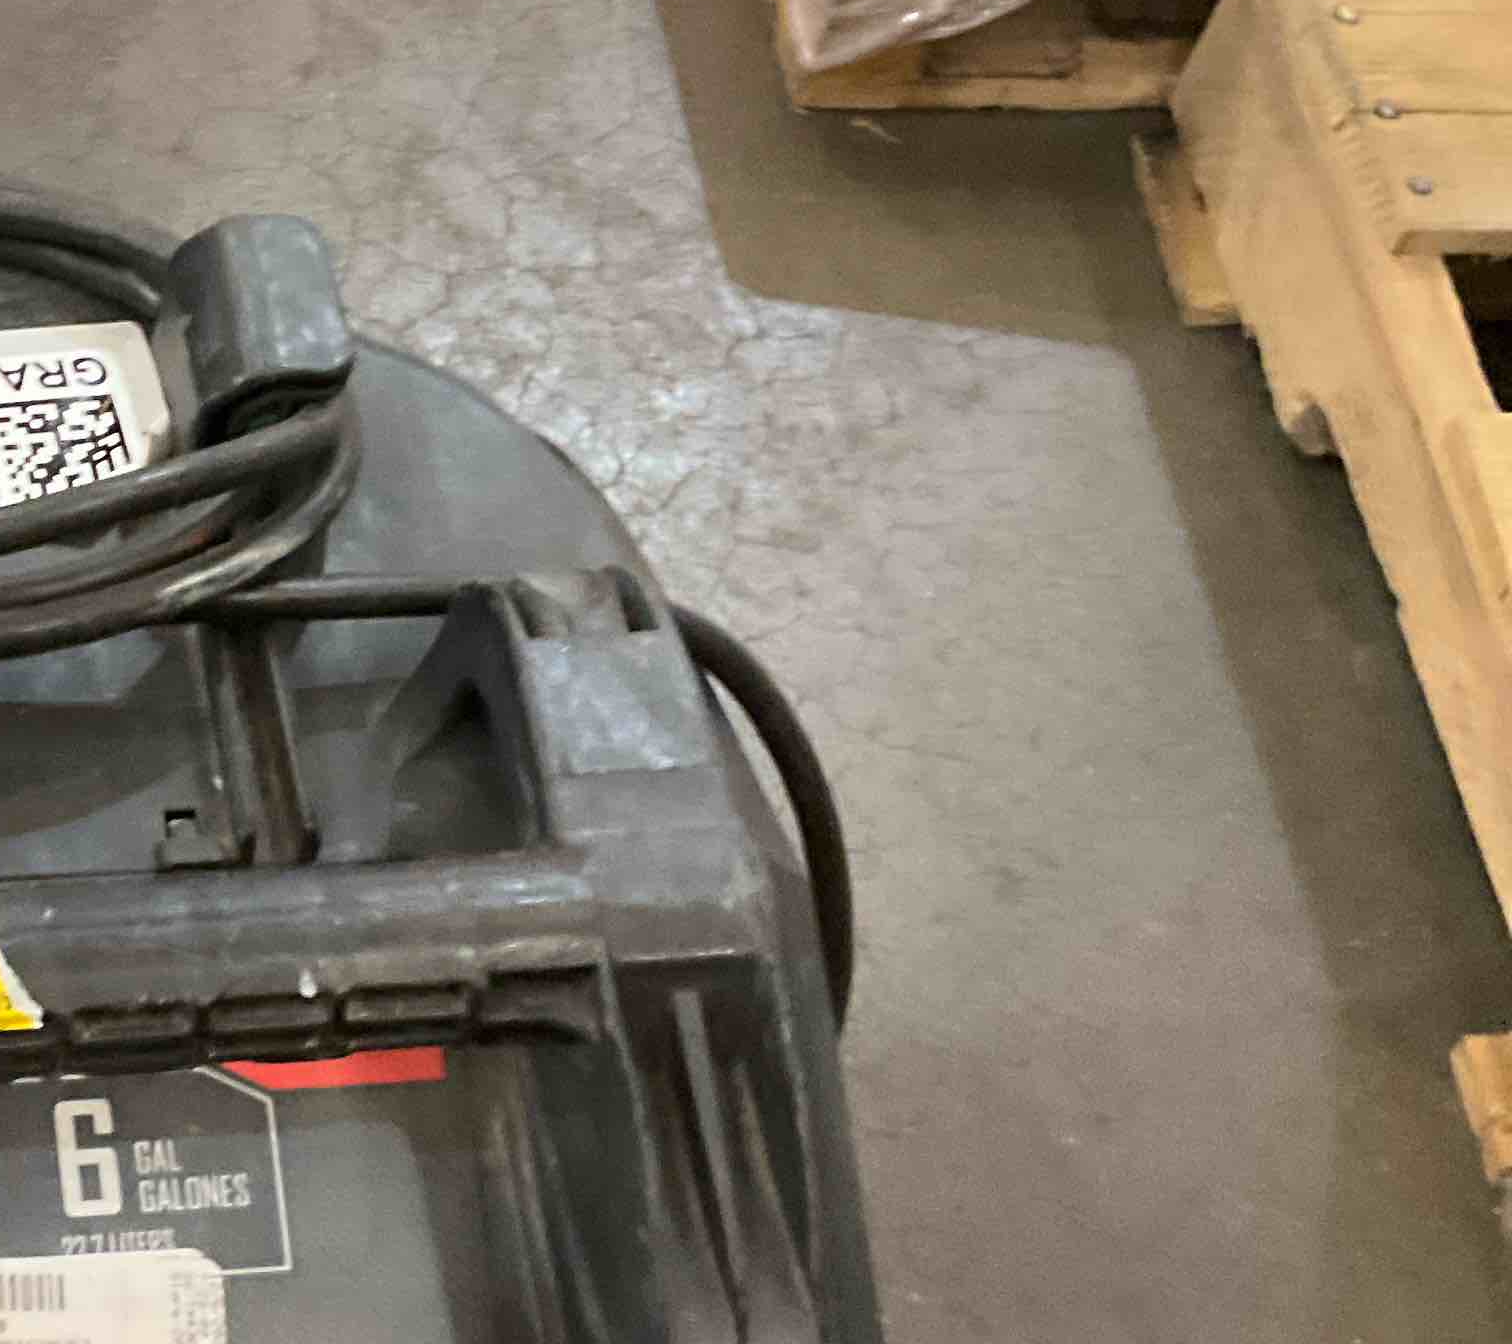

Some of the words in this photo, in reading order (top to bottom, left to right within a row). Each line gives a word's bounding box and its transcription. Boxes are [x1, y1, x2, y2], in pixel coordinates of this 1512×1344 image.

[53, 1097, 123, 1219] 6
[133, 1138, 183, 1175] GAL
[138, 1171, 253, 1214] GALONES
